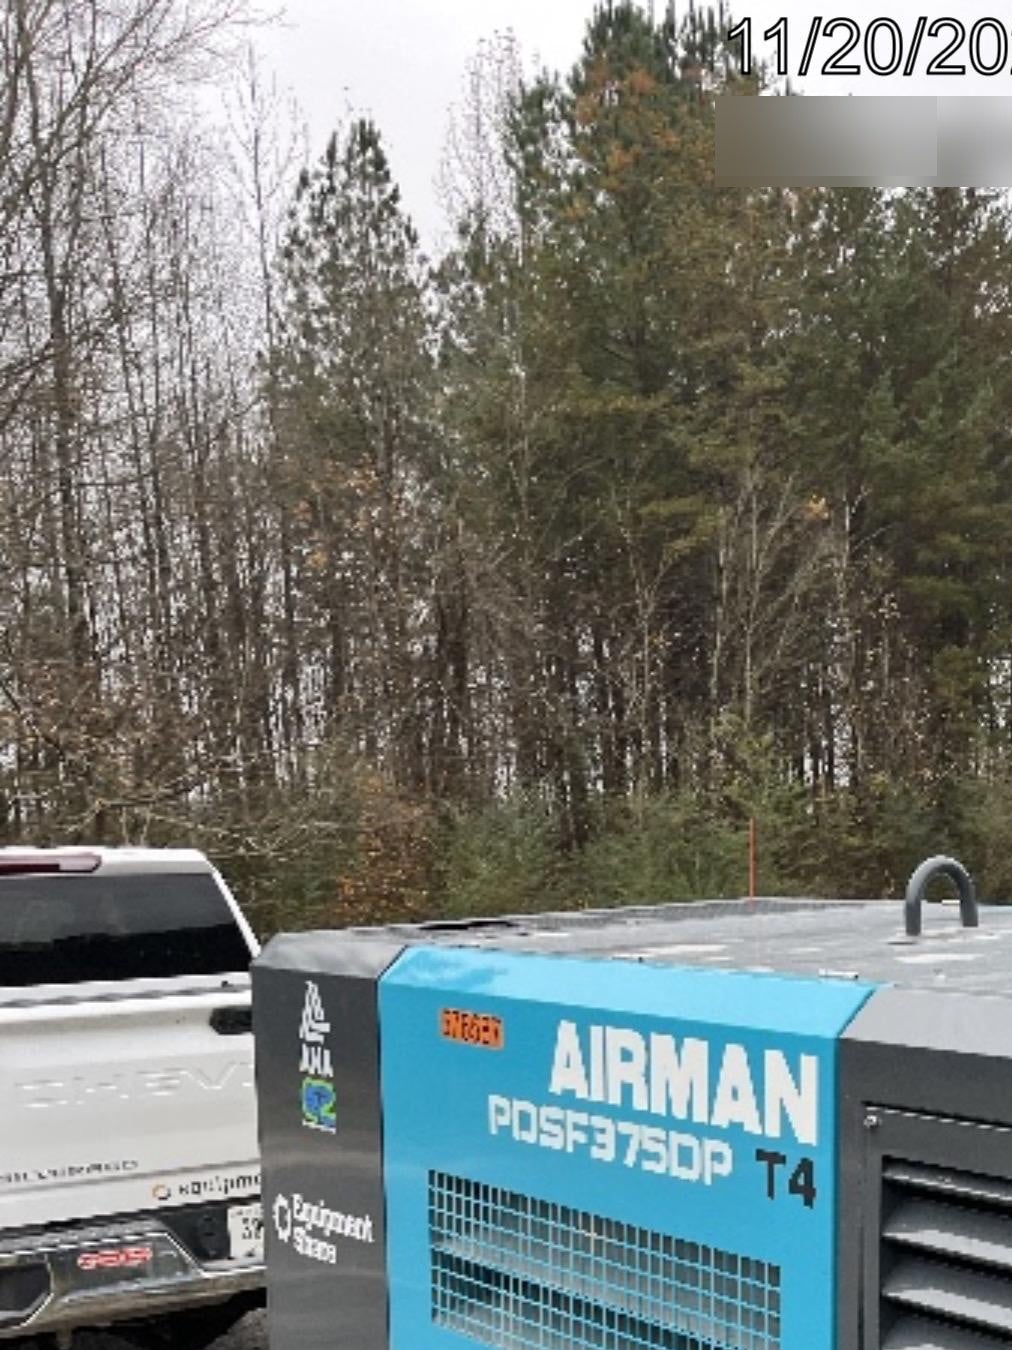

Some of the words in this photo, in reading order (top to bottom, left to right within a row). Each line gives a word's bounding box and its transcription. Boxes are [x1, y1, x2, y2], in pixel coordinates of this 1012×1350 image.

[548, 1019, 819, 1147] AIRMAN
[487, 1094, 734, 1186] PDSF375DP
[755, 1148, 817, 1210] T4
